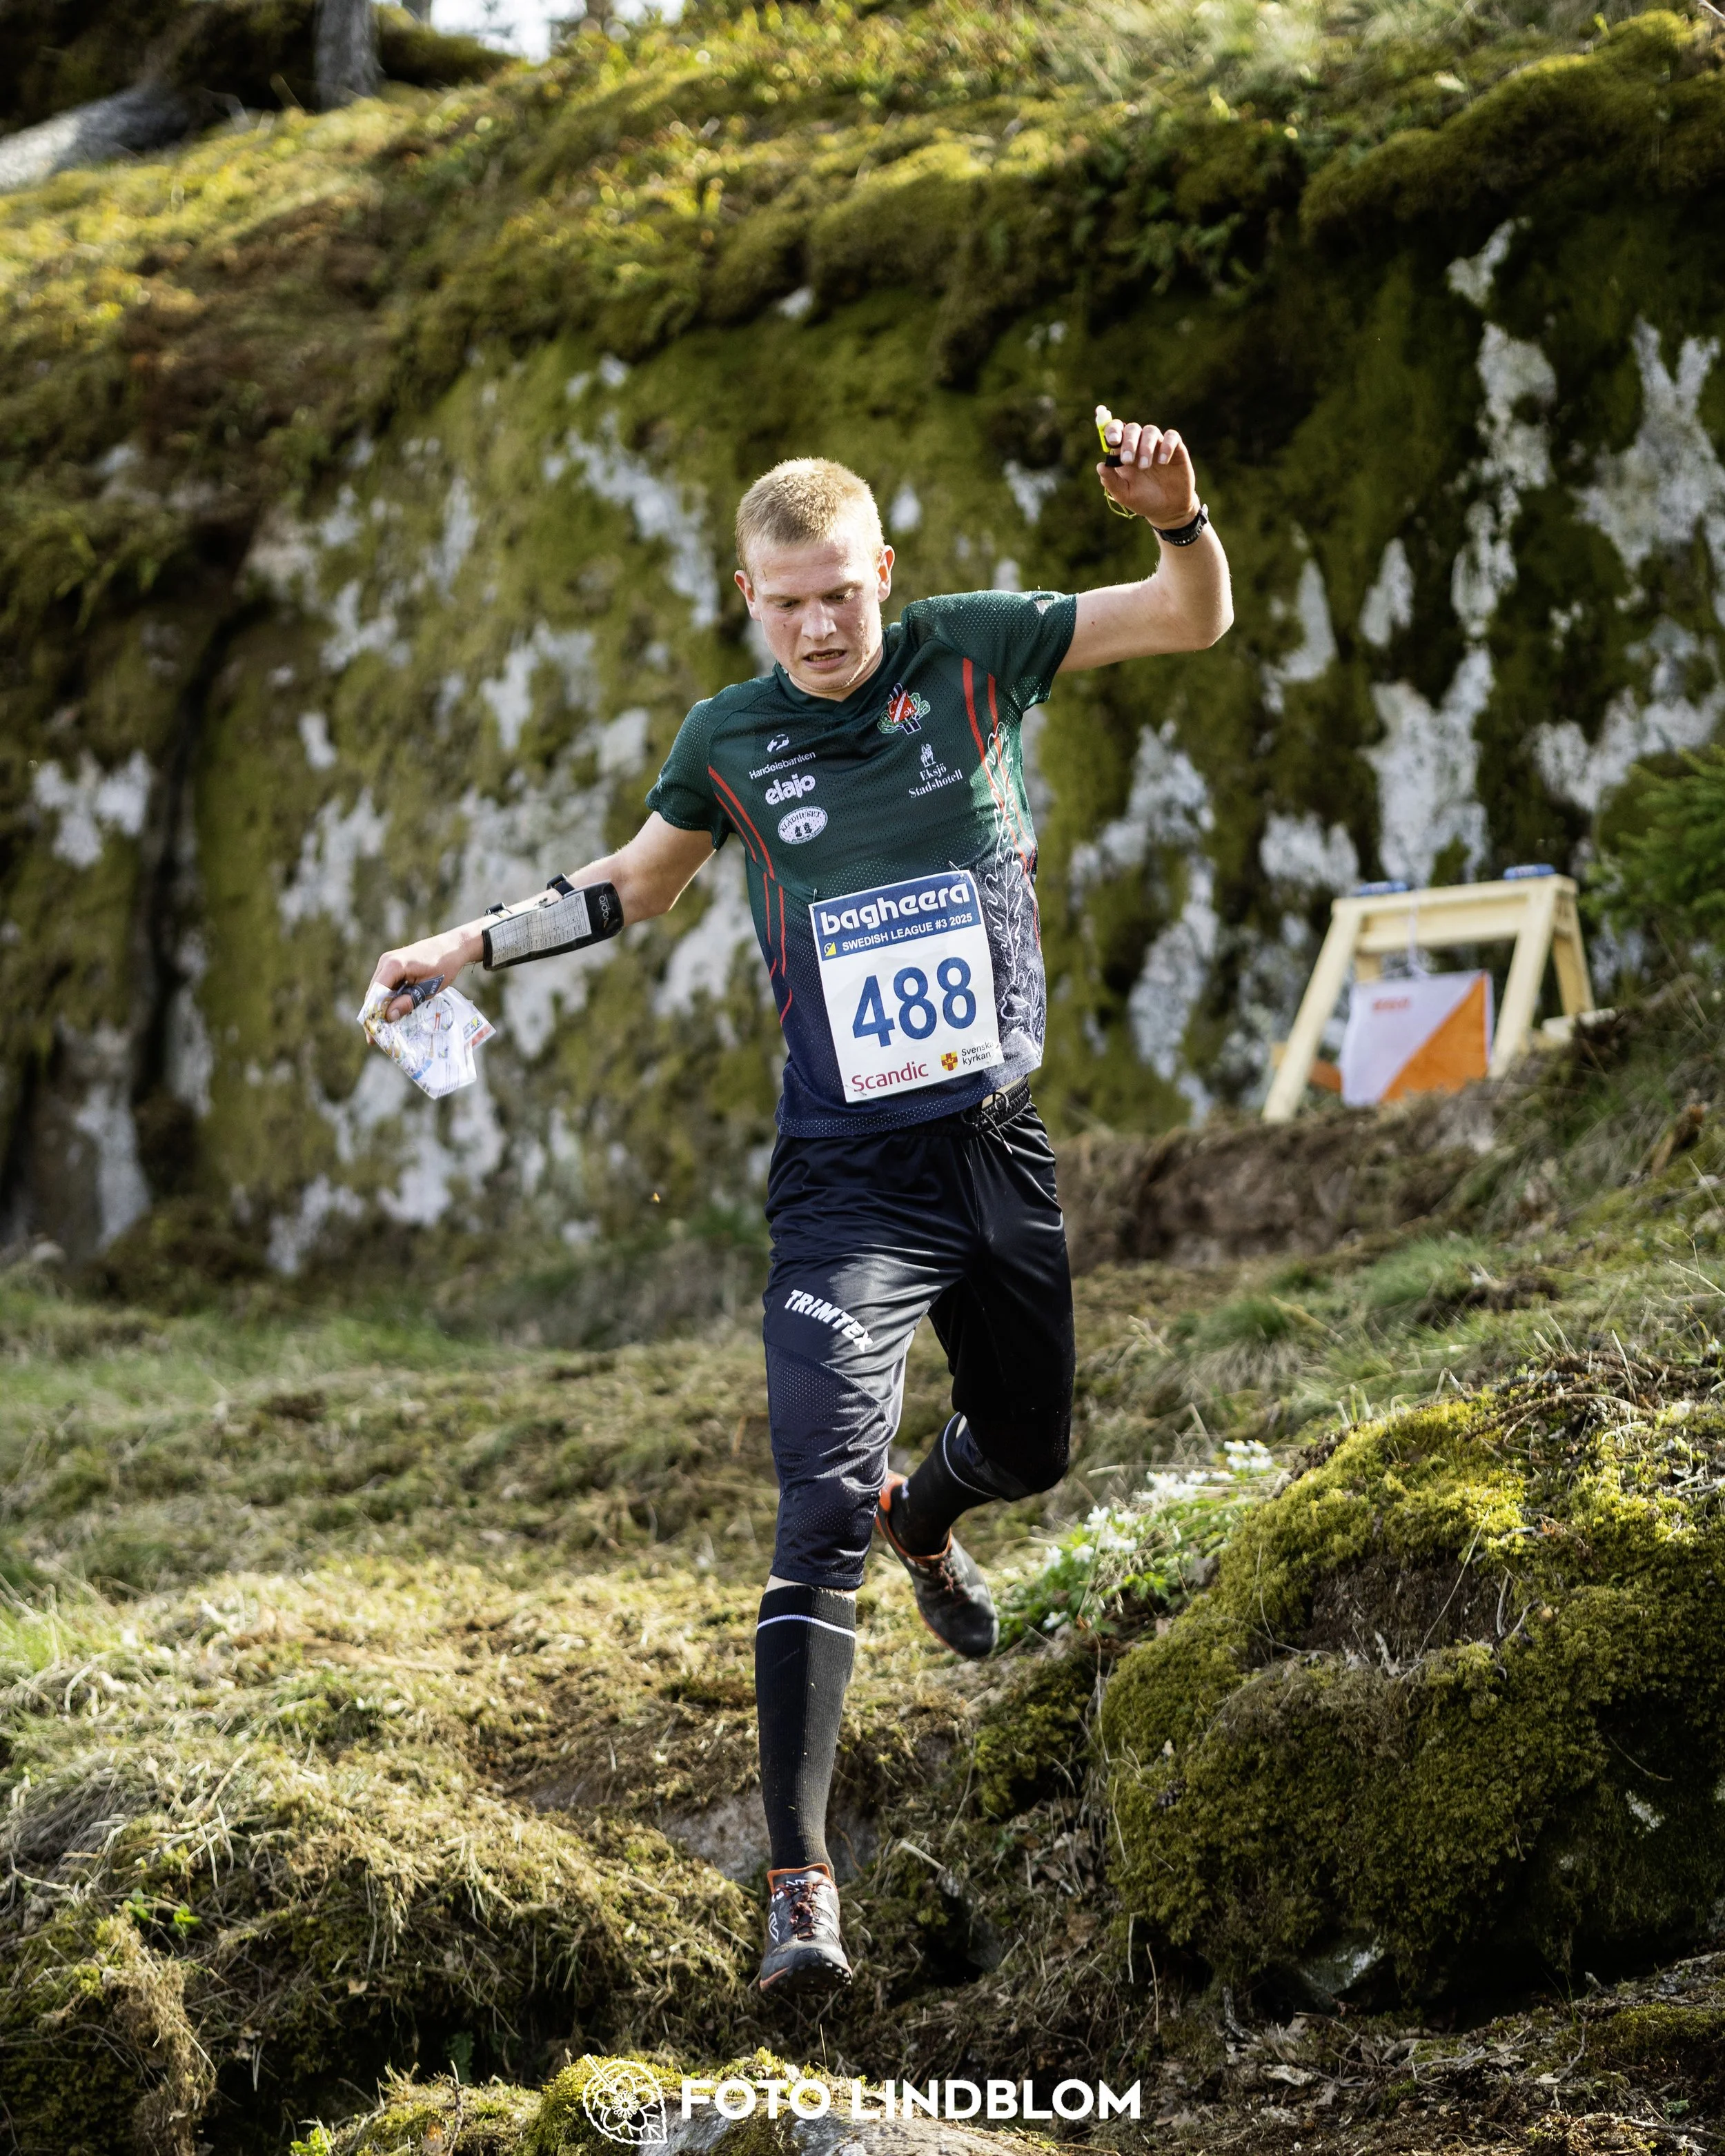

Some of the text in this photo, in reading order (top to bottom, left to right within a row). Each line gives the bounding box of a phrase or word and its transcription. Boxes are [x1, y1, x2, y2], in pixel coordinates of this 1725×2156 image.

[749, 752, 816, 780] Handelsbanken
[920, 763, 947, 782] Eksjö
[765, 774, 816, 805] elajo
[909, 769, 963, 798] Stadshotell
[820, 883, 970, 936] bagheera
[842, 913, 973, 951] SWEDISH LEAGUE #3 2025
[852, 957, 976, 1047] 488
[961, 1042, 994, 1056] Svenska
[963, 1051, 991, 1066] kyrkan
[851, 1061, 929, 1093] Scandic
[785, 1289, 873, 1352] TRIMTEX
